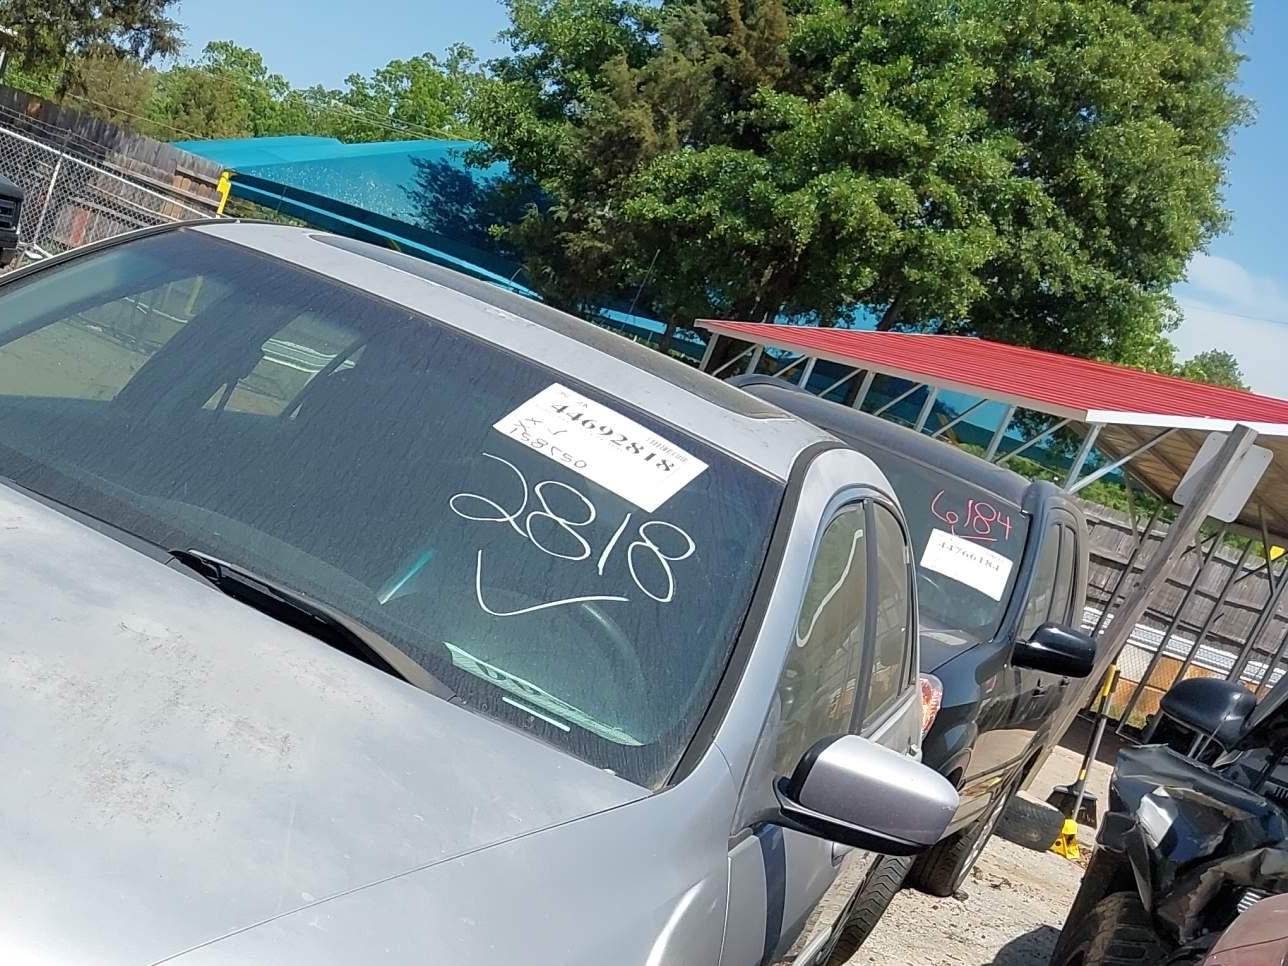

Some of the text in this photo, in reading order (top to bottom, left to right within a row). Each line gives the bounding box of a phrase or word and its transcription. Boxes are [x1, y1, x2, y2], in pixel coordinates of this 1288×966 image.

[551, 403, 674, 472] 44692818
[450, 452, 696, 603] 2818
[931, 490, 1012, 541] 6184
